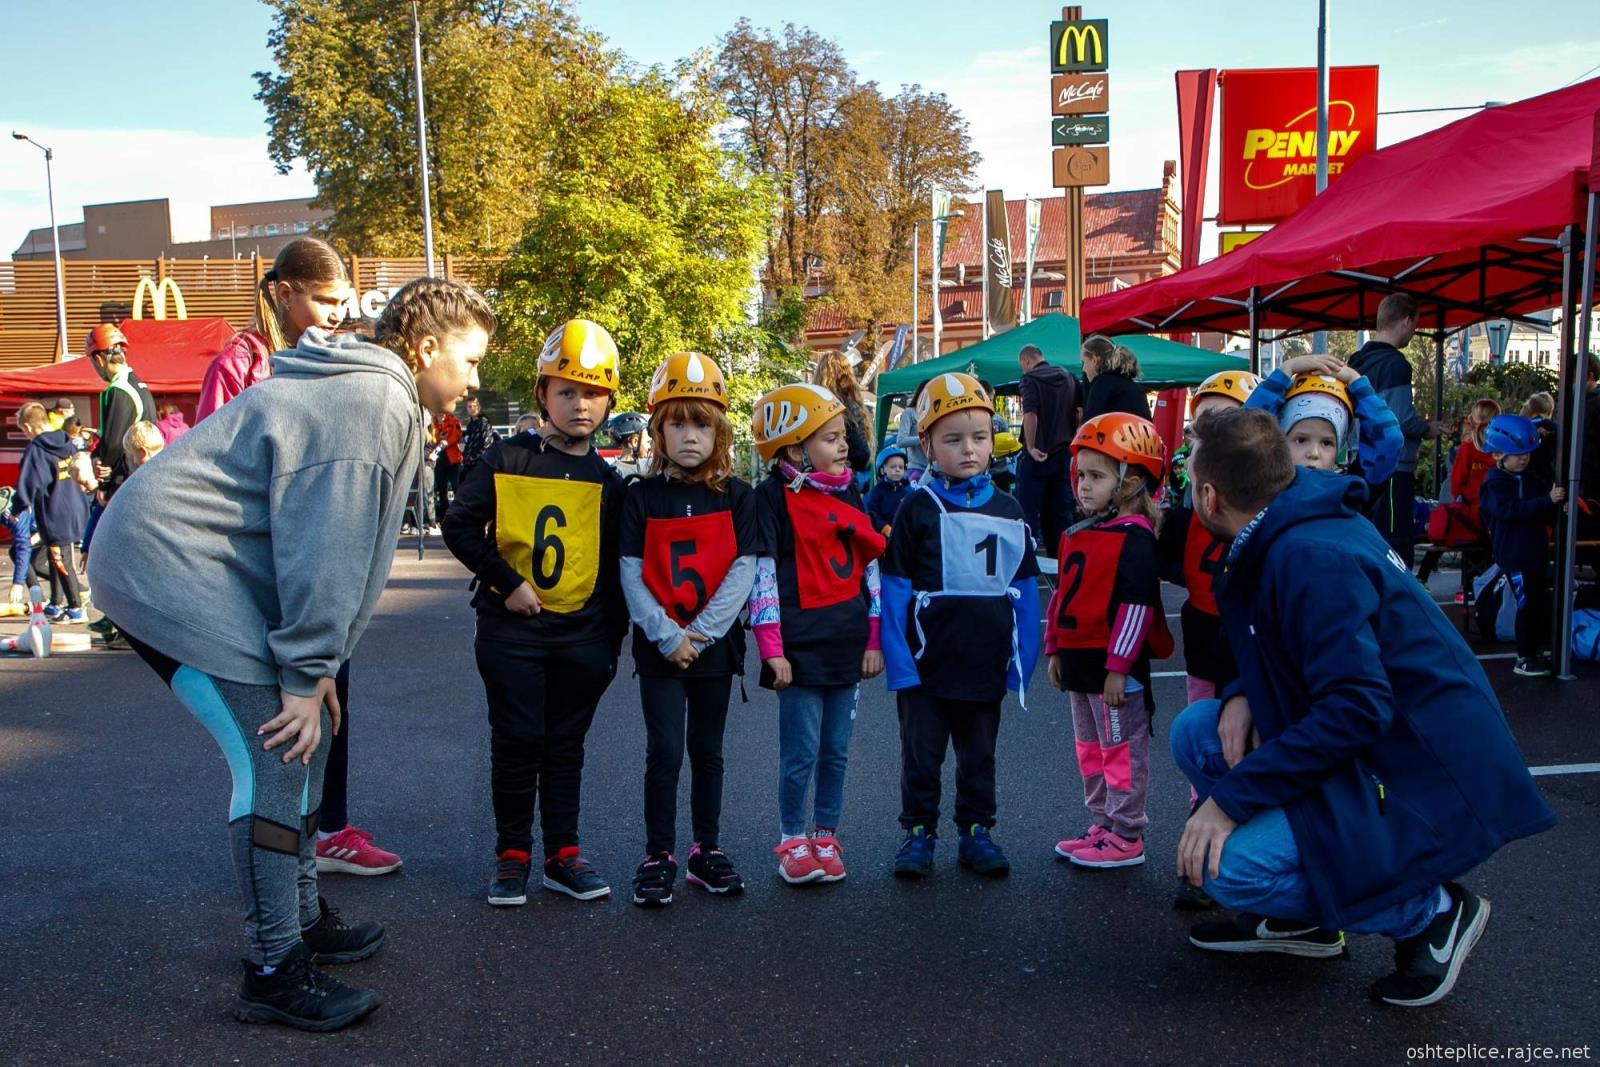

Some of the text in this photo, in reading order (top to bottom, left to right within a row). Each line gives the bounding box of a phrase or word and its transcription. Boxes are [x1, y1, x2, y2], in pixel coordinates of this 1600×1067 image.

[1283, 162, 1344, 176] MARET
[570, 369, 600, 381] CAMP
[1311, 382, 1342, 393] CAMP
[680, 386, 710, 394] CAMP
[945, 397, 974, 409] CAMP
[531, 504, 566, 590] 6
[975, 534, 999, 577] 1
[670, 539, 706, 620] 5
[1057, 551, 1086, 630] 2
[1109, 705, 1122, 743] UNNING
